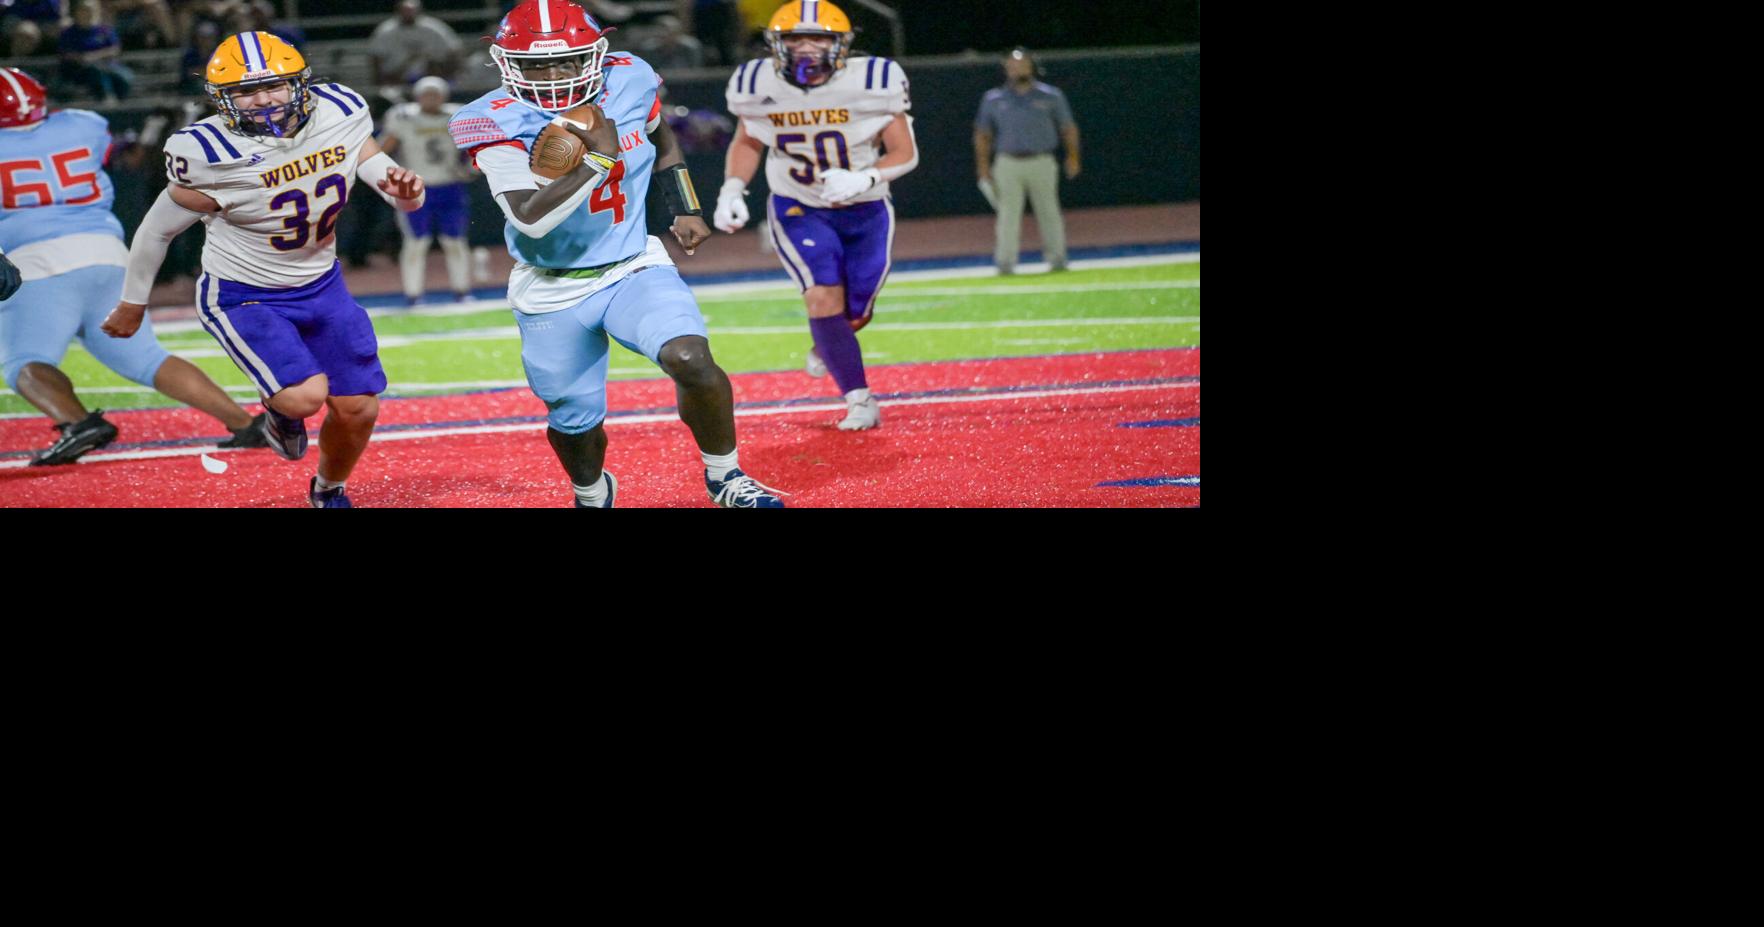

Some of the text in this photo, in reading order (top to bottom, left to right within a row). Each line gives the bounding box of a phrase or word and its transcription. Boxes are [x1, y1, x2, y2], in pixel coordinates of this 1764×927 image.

[618, 129, 645, 153] UX
[767, 108, 849, 127] WOLVES
[0, 147, 101, 209] 65
[259, 145, 346, 188] WOLVES
[776, 130, 851, 185] 50
[269, 173, 347, 251] 32
[588, 159, 627, 225] 4
